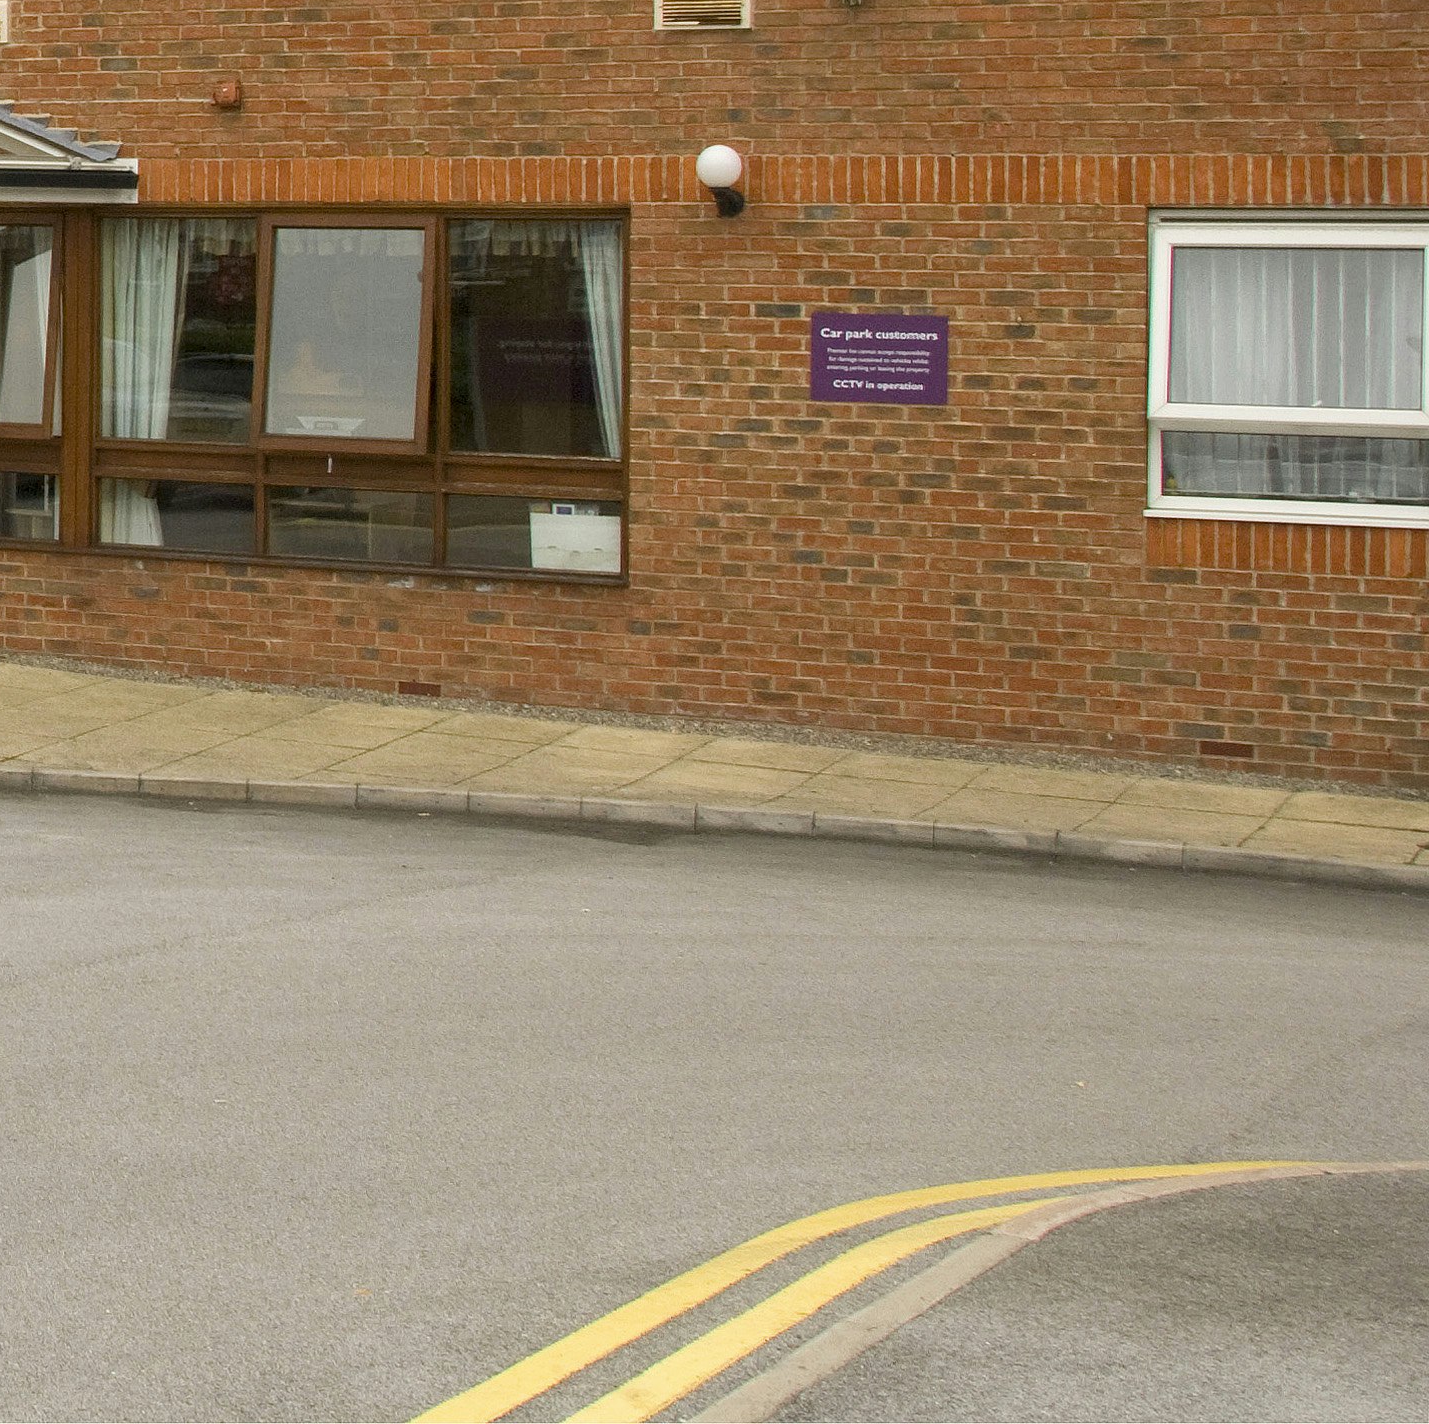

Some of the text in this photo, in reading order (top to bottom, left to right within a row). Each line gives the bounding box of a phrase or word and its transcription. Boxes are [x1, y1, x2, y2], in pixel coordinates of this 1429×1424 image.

[820, 327, 939, 341] Car park customers
[832, 379, 924, 392] CCTV in operation
